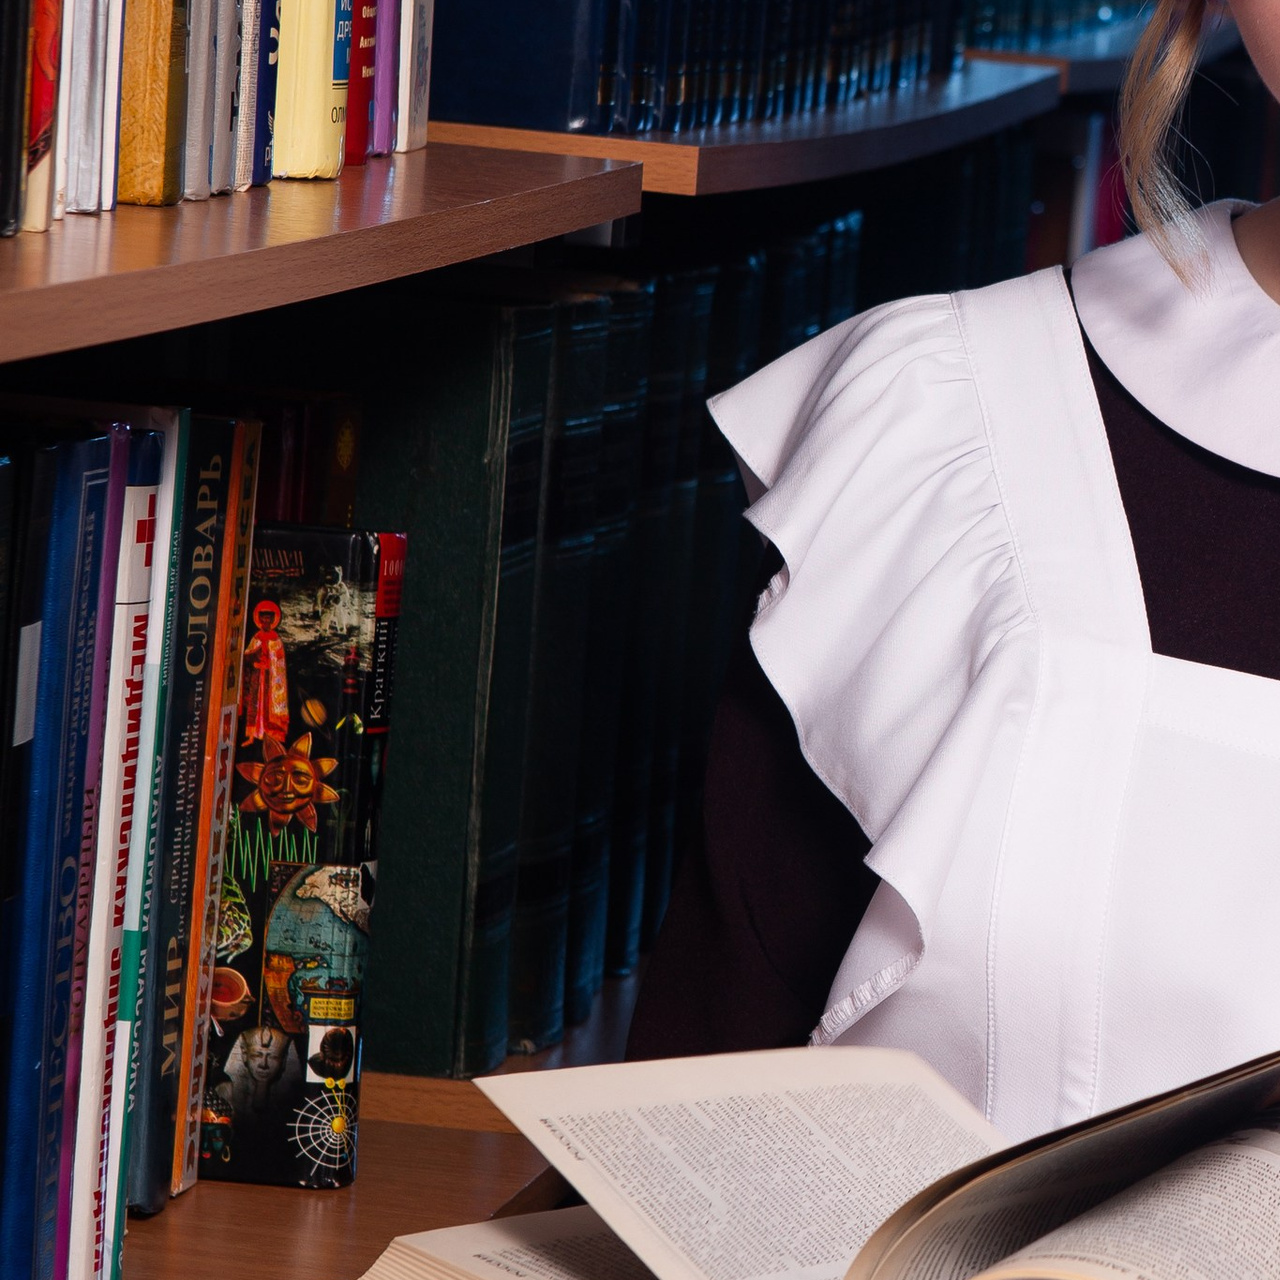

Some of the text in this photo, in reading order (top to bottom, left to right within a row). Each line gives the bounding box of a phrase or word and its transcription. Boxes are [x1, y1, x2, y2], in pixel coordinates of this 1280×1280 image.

[170, 530, 178, 563] КУРС
[184, 454, 223, 676] СЛОВАРЬ
[62, 510, 97, 837] энциклопедический
[79, 609, 97, 735] словарь
[161, 597, 174, 686] НАЧИНАЮЩИХ
[370, 621, 388, 719] Краткий
[112, 613, 148, 928] МЕДИЦИНСКАЯ
[183, 440, 256, 1174] ЭНЦИКЛОПЕДИЯ РЕМЕСЕЛ
[126, 754, 165, 1113] АНАТОМИЯ МАССАЖА
[160, 936, 184, 1078] МИР
